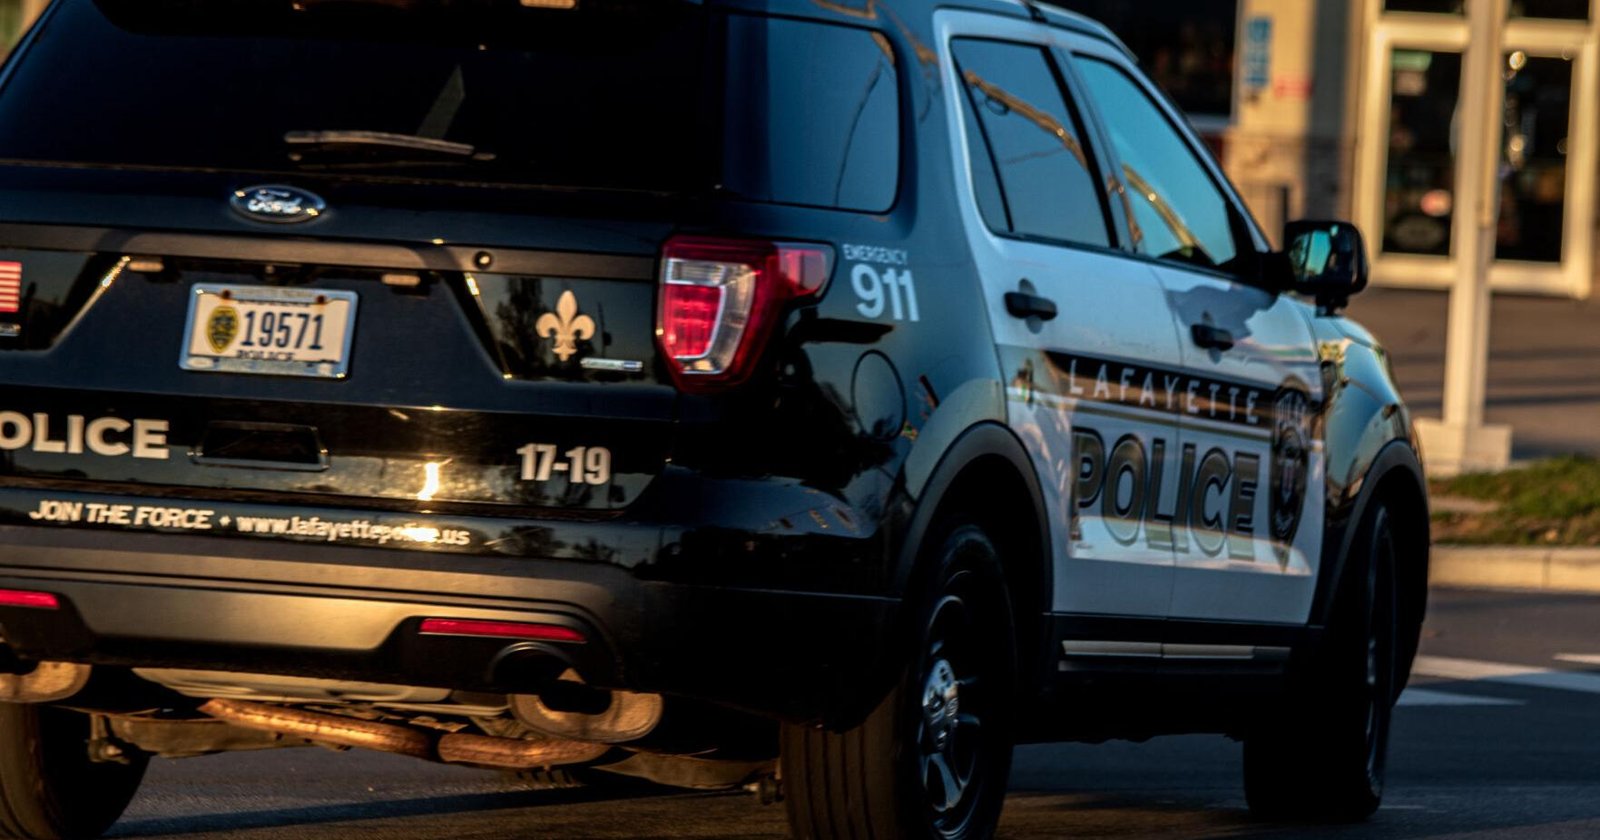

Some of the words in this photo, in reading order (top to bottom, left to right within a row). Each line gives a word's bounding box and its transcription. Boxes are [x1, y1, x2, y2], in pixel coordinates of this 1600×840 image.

[248, 189, 302, 214] Ford
[843, 244, 908, 265] EMERGENCY
[851, 263, 919, 322] 911
[241, 310, 324, 350] 19571
[1069, 359, 1261, 424] LAFAYETTE
[516, 443, 611, 485] 17-19
[1071, 425, 1260, 562] POLICE
[29, 500, 83, 521] JOIN
[86, 503, 133, 525] THE
[134, 506, 214, 529] FORCE
[236, 516, 470, 546] www.lafayettepolie.us
